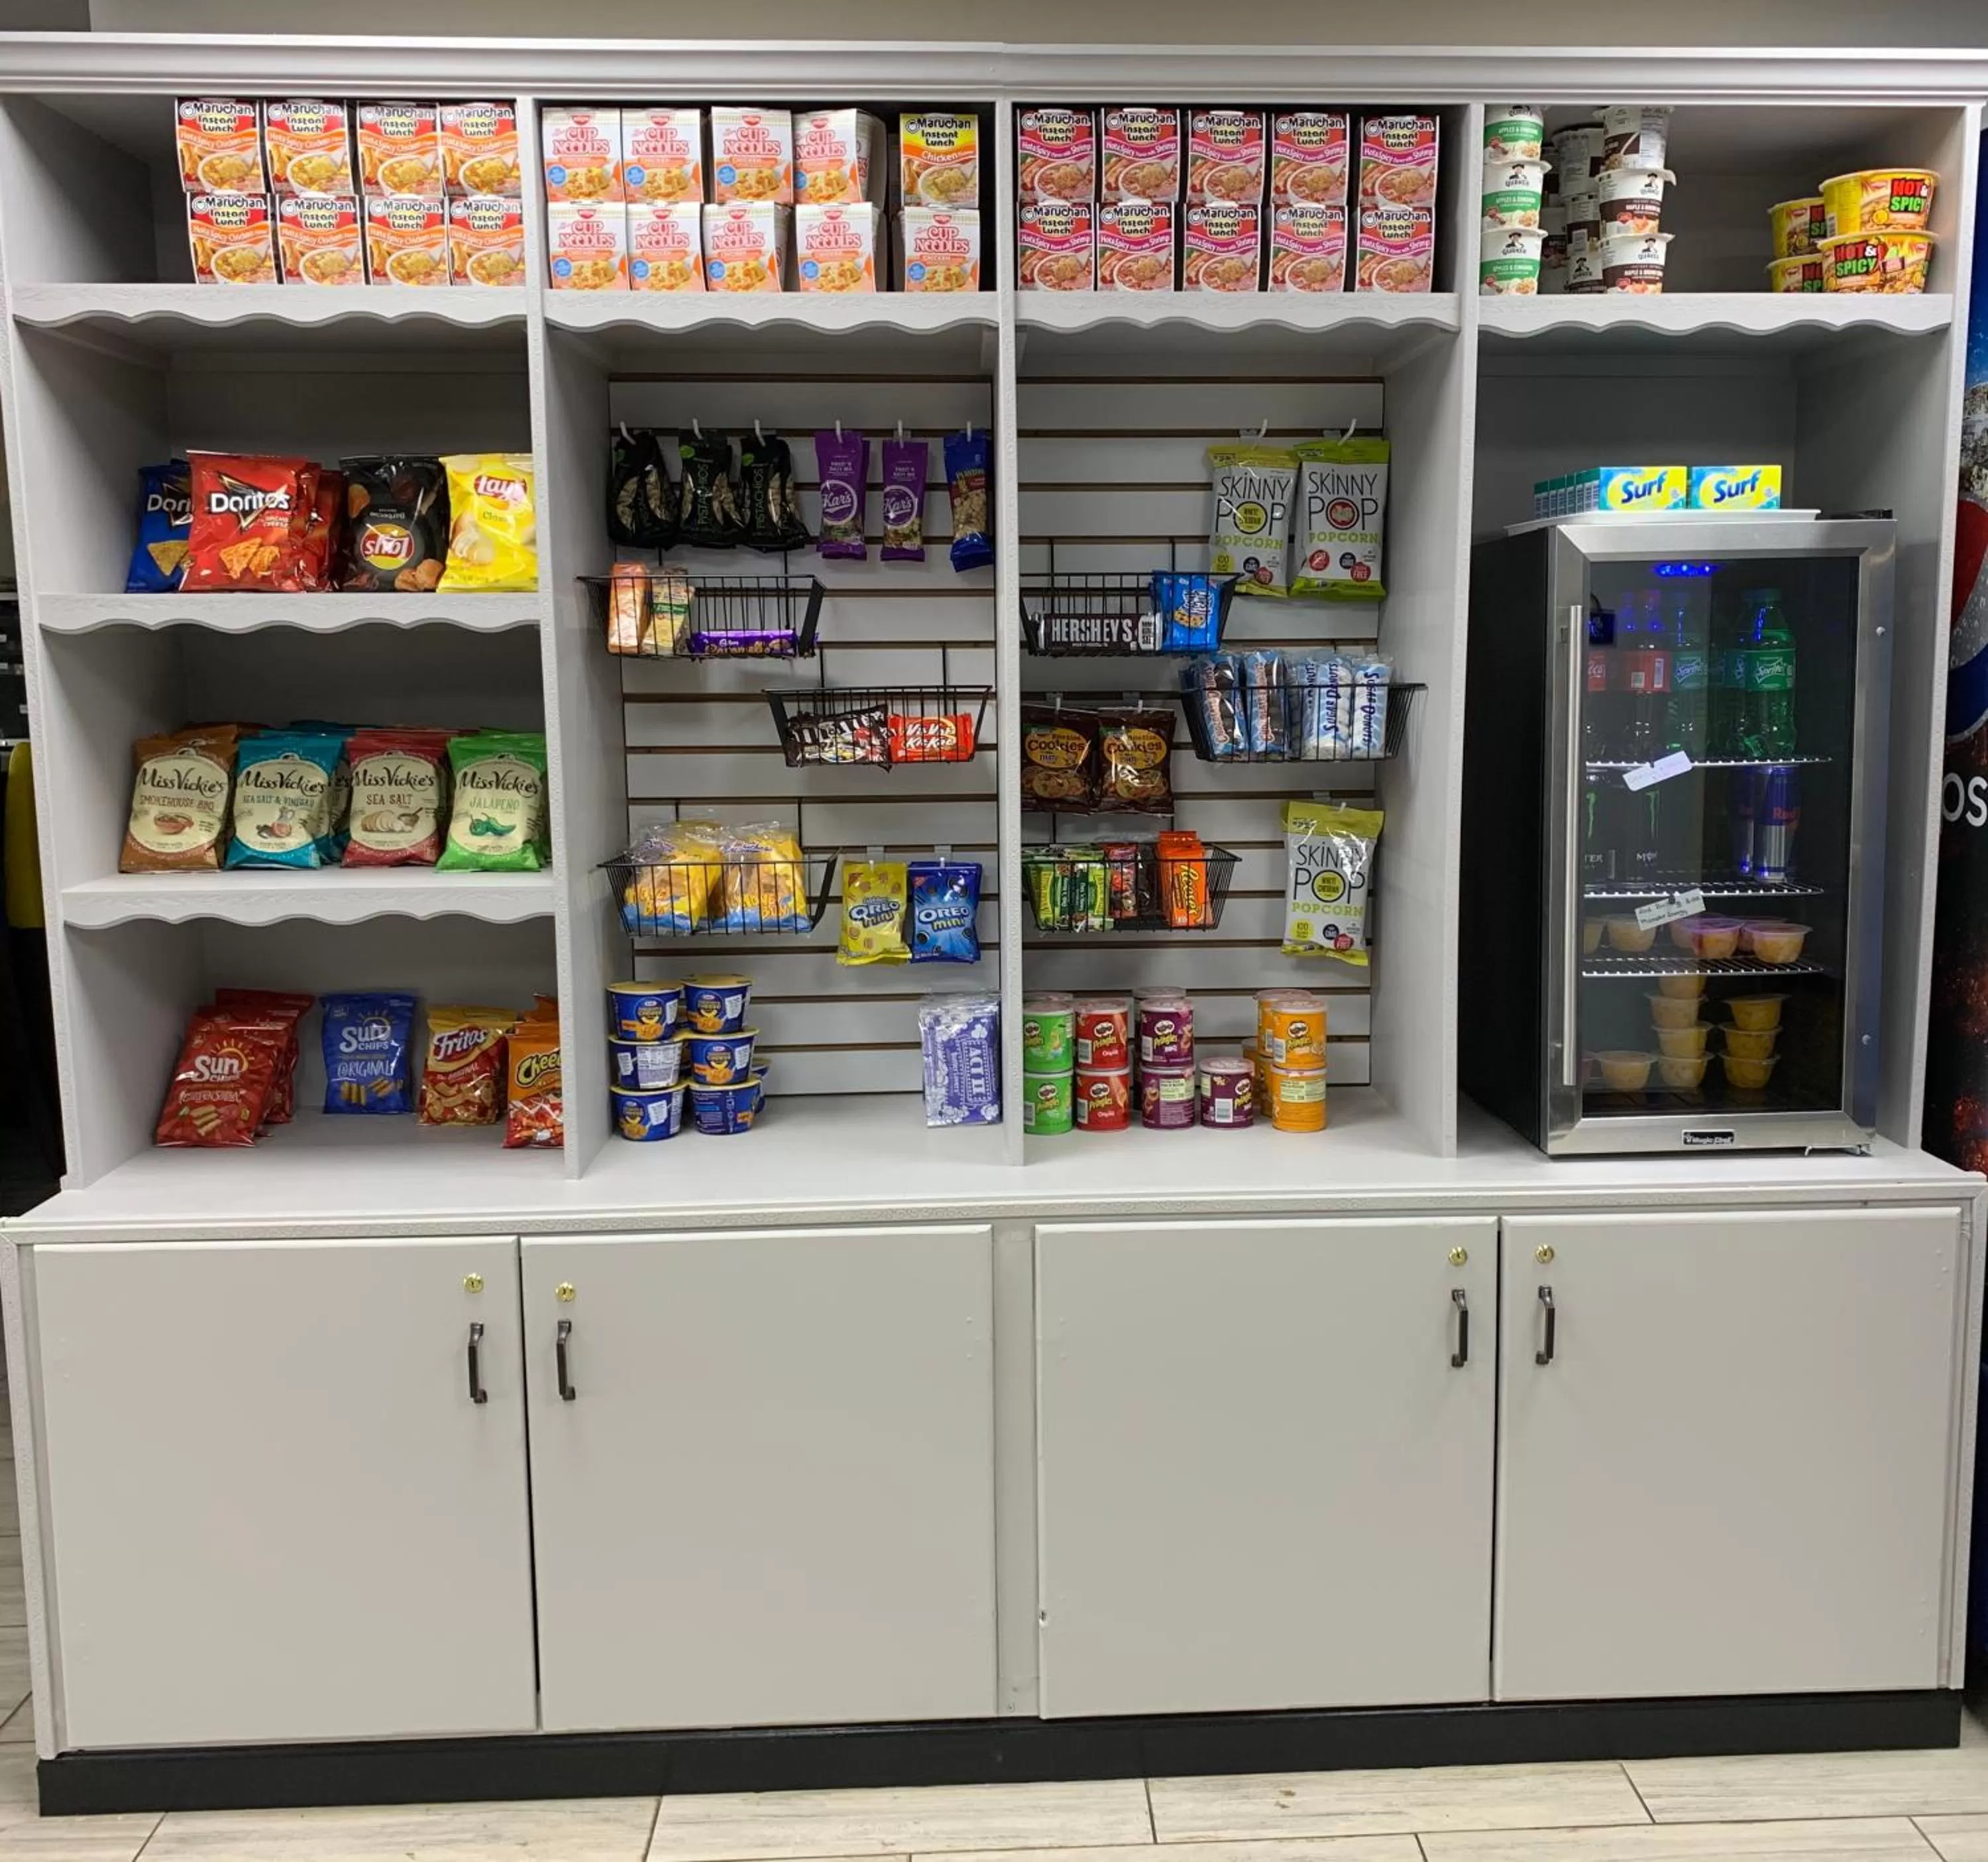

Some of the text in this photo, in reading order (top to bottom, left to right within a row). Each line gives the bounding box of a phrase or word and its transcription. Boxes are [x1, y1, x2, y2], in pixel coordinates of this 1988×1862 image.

[193, 103, 251, 114] Maruchan
[282, 104, 340, 115] Maruchan
[375, 107, 431, 117] Maruchan
[455, 107, 512, 117] Maruchan
[917, 118, 970, 129] Maruchan
[1034, 113, 1088, 125] Maruchan
[1119, 114, 1174, 124] Maruchan
[1206, 117, 1258, 126] Maruchan
[1290, 117, 1343, 129] Maruchan
[1378, 120, 1432, 131] Maruchan
[566, 127, 598, 140] CUP
[646, 127, 677, 140] CUP
[737, 127, 769, 142] CUP
[806, 130, 835, 143] CUP
[553, 139, 610, 154] NOODLES
[632, 140, 689, 154] NOODLES
[724, 140, 781, 155] NOODLES
[796, 141, 846, 158] NOODLES
[922, 150, 958, 160] Chicken
[1892, 180, 1921, 196] HOT
[206, 197, 265, 207] Maruchan
[294, 201, 353, 211] Maruchan
[384, 201, 440, 211] Maruchan
[464, 201, 520, 212] Maruchan
[1034, 207, 1087, 217] Maruchan
[1115, 207, 1168, 217] Maruchan
[1201, 209, 1253, 218] Maruchan
[1290, 209, 1342, 220] Maruchan
[1375, 211, 1428, 221] Maruchan
[572, 222, 604, 233] CUP
[647, 222, 678, 233] CUP
[819, 223, 850, 235] CUP
[928, 227, 959, 239] CUP
[559, 233, 616, 248] NOODLES
[636, 234, 689, 248] NOODLES
[806, 234, 861, 249] NOODLES
[915, 239, 969, 252] NOODLES
[1836, 243, 1865, 260] HOT
[1836, 258, 1876, 276] SPICY
[476, 476, 527, 502] Lay's
[1622, 470, 1667, 504] Surf
[1713, 469, 1759, 503] Surf
[146, 494, 191, 512] Dori
[211, 492, 291, 513] Doritos
[822, 492, 851, 507] Kar's
[885, 496, 911, 512] Kar's
[1215, 498, 1286, 535] POP
[1308, 496, 1378, 530] POP
[1214, 535, 1283, 549] POPCORN
[1309, 531, 1378, 544] POPCORN
[365, 535, 409, 558] Lay's
[1052, 618, 1132, 643] HERSHEY'S
[1757, 663, 1784, 677] Sprite
[1028, 739, 1085, 751] Cookies
[140, 767, 224, 798] Miss Vickie's
[243, 769, 326, 795] Miss Vickie's
[353, 765, 435, 791] Miss Vickie's
[461, 770, 539, 798] Miss Vickie's
[198, 800, 214, 811] BBQ
[366, 794, 413, 805] SEA SALT
[1294, 867, 1366, 904] POP
[850, 901, 900, 920] OREO
[918, 907, 969, 923] OREO
[1292, 902, 1363, 916] POPCORN
[339, 1024, 391, 1053] Sun
[433, 1028, 487, 1060] Fritos
[191, 1055, 239, 1082] Sun
[518, 1052, 561, 1084] Chee
[969, 1047, 984, 1077] ACT
